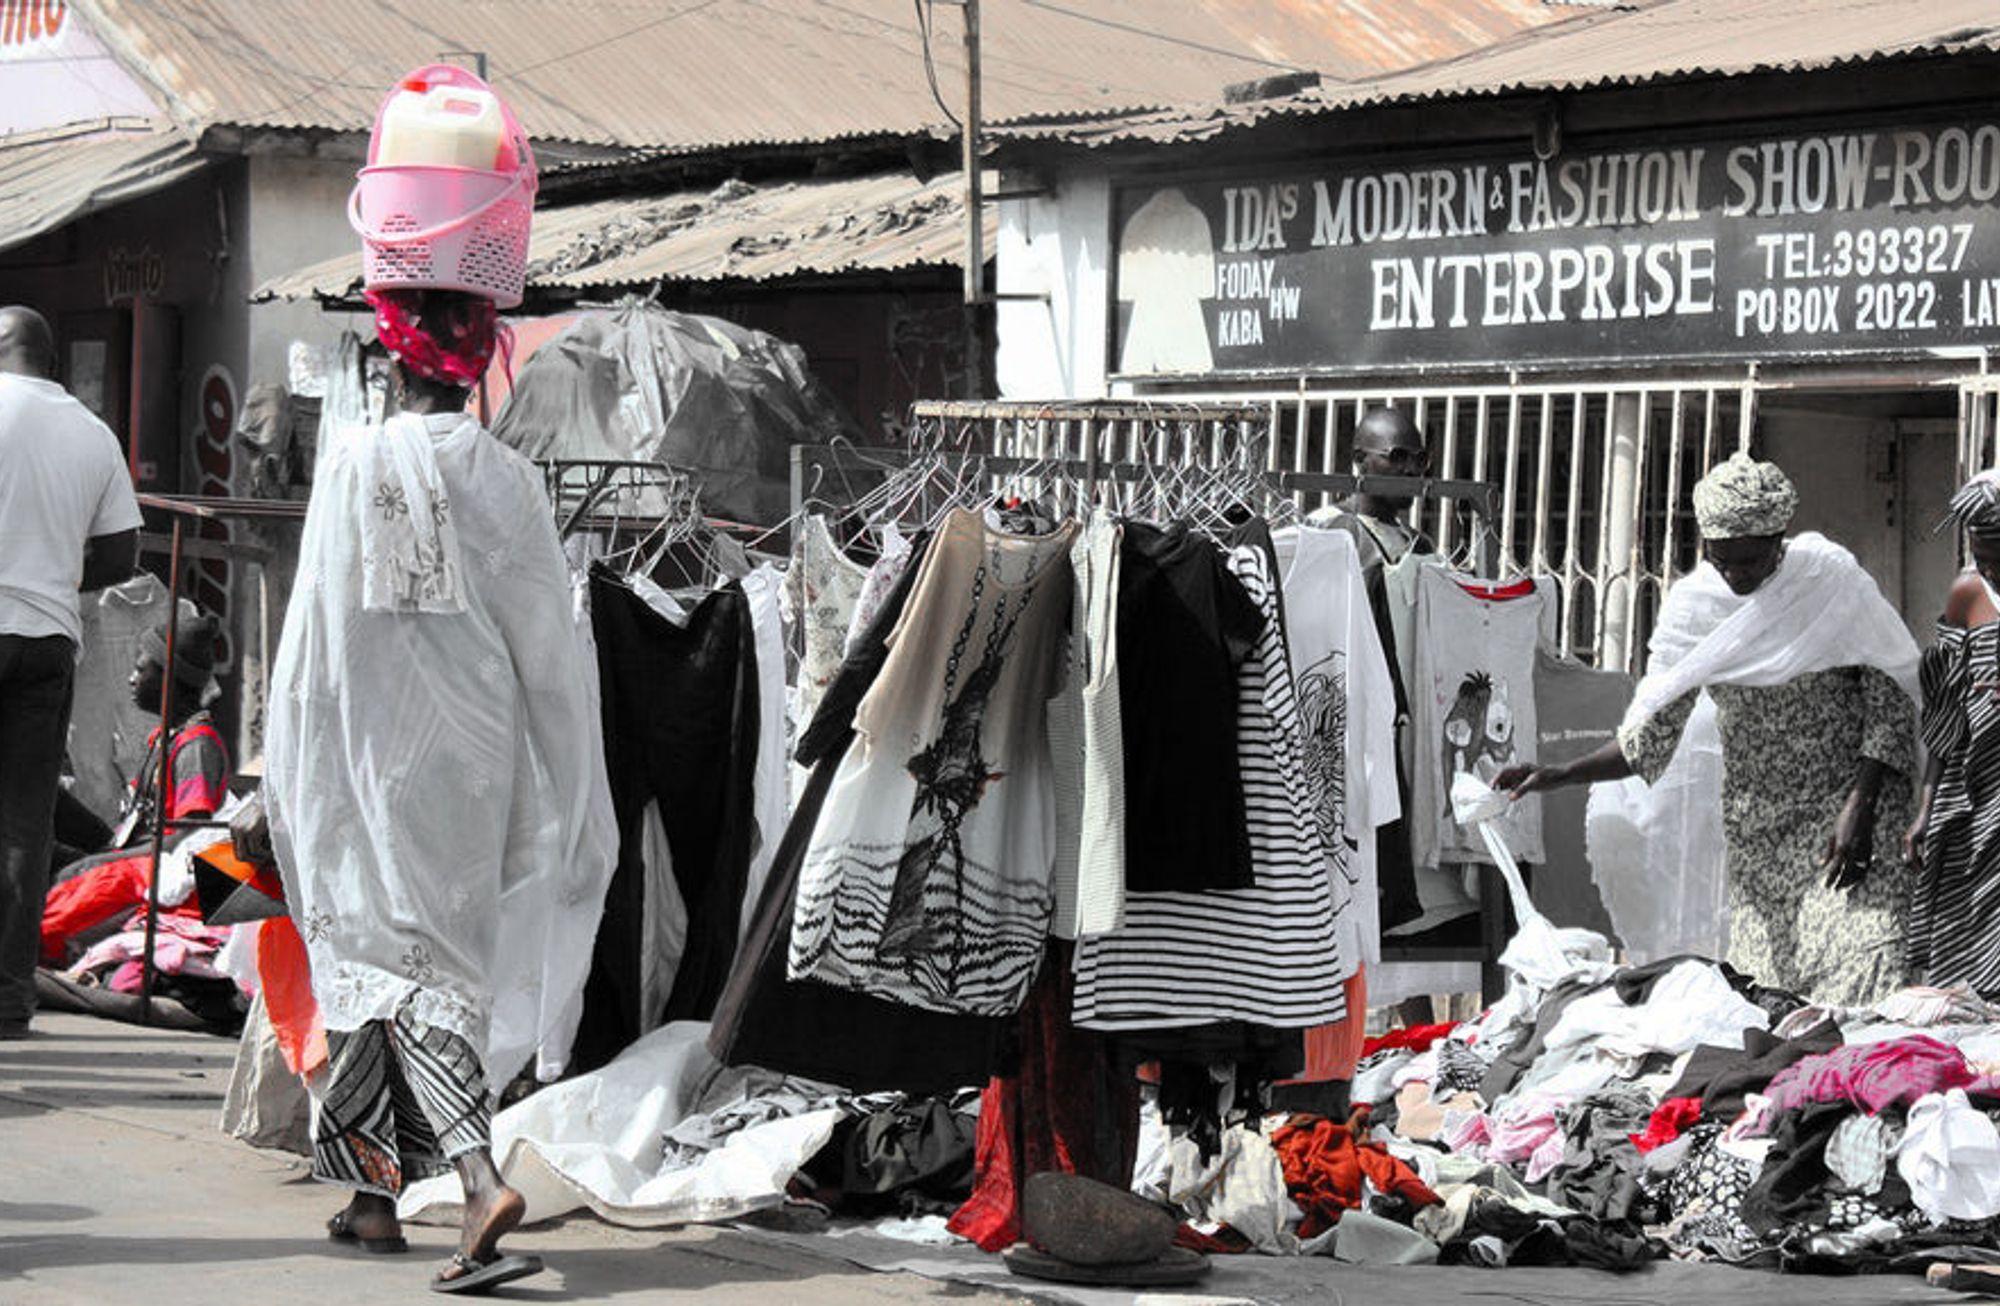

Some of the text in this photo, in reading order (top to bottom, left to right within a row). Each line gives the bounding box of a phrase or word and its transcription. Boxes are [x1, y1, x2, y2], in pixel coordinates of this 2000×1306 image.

[1222, 184, 1299, 253] IDA'S
[1311, 166, 1488, 247] MODERN
[1490, 176, 1507, 211] &
[1508, 150, 1705, 232] FASHION
[1217, 259, 1275, 300] FODAY
[1369, 239, 1716, 331] ENTERPRISE
[1217, 310, 1265, 347] KABA
[1855, 281, 1937, 331] 2022
